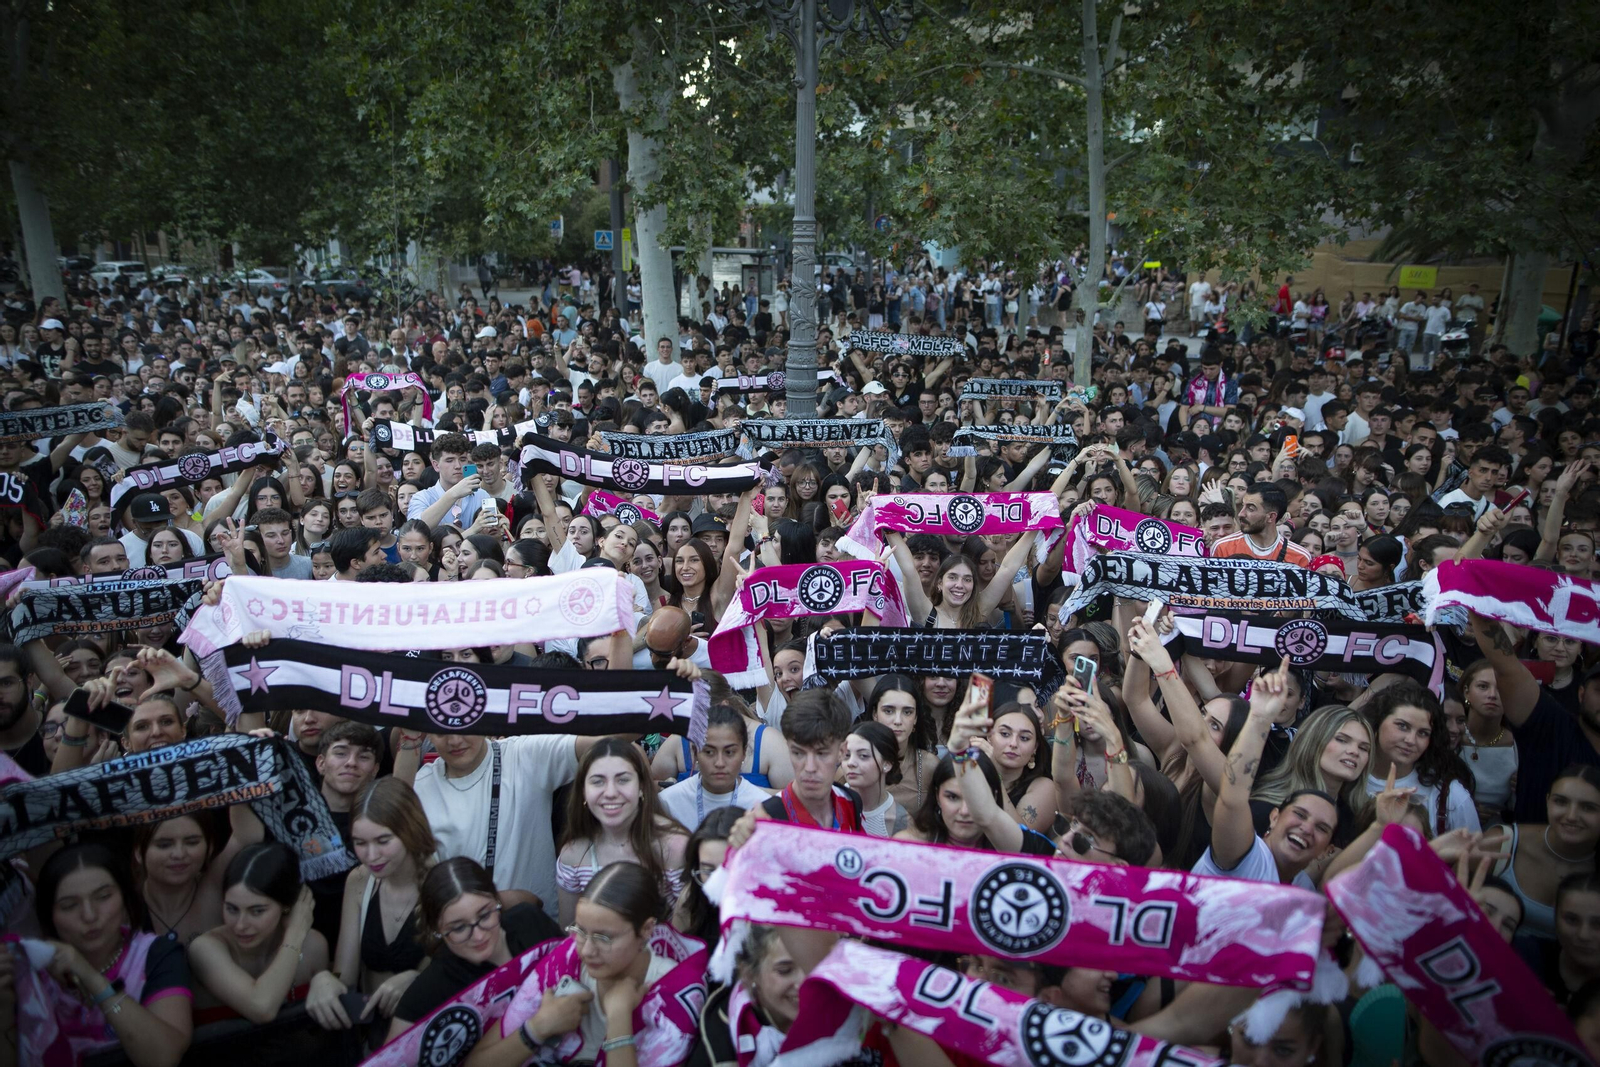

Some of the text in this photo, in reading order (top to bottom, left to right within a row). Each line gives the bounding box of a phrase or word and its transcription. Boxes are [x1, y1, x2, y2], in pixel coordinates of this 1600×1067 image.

[738, 375, 763, 390] DL
[129, 442, 258, 490] DL FC
[559, 449, 604, 483] DL
[662, 463, 708, 487] FC
[905, 502, 943, 526] FC
[992, 503, 1023, 523] DL
[1097, 514, 1127, 541] DL
[1204, 559, 1249, 569] Diciembre
[86, 580, 136, 592] Diciembre
[750, 579, 789, 609] DL
[851, 568, 885, 598] FC
[802, 569, 841, 588] DELLAFUENTE
[1169, 594, 1317, 610] Palacio de los deportes GRANADA
[52, 623, 84, 633] Palacio
[86, 622, 99, 632] de
[1202, 615, 1410, 665] DL FC
[1278, 621, 1326, 641] DELLAFUENTE
[817, 644, 1008, 661] DELLAFUENTE
[339, 664, 581, 724] DL FC
[430, 670, 484, 697] DELLAFUENTE
[447, 717, 463, 726] F.C.
[102, 740, 211, 775] Diciembre 2022
[204, 782, 274, 806] GRANADA
[487, 797, 499, 867] SUPREME
[857, 866, 955, 933] FC
[979, 909, 1061, 951] DELLAFUENTE
[1091, 896, 1179, 949] DL
[1414, 934, 1503, 1028] DL
[913, 963, 999, 1029] DL
